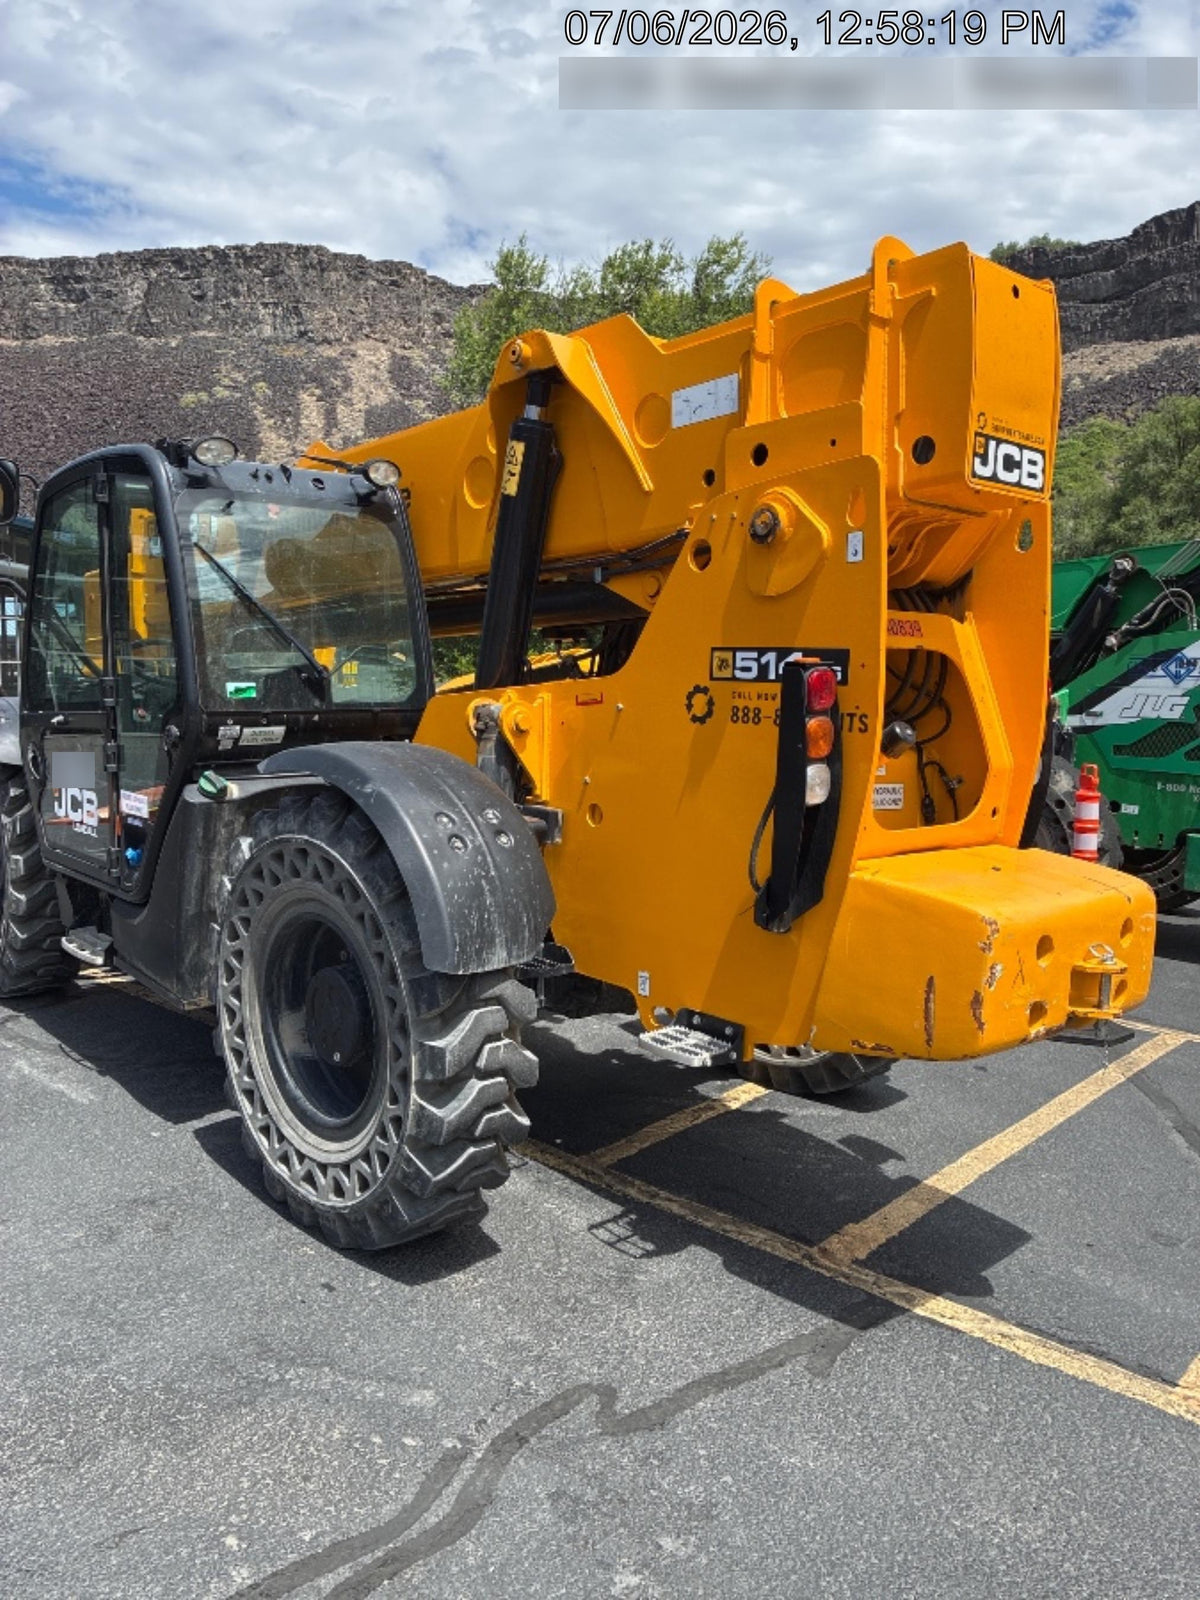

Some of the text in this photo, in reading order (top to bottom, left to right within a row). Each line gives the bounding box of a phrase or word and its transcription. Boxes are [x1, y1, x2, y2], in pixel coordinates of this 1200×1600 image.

[974, 440, 1044, 489] JCB
[1119, 694, 1191, 719] JLG
[54, 787, 98, 827] JCB
